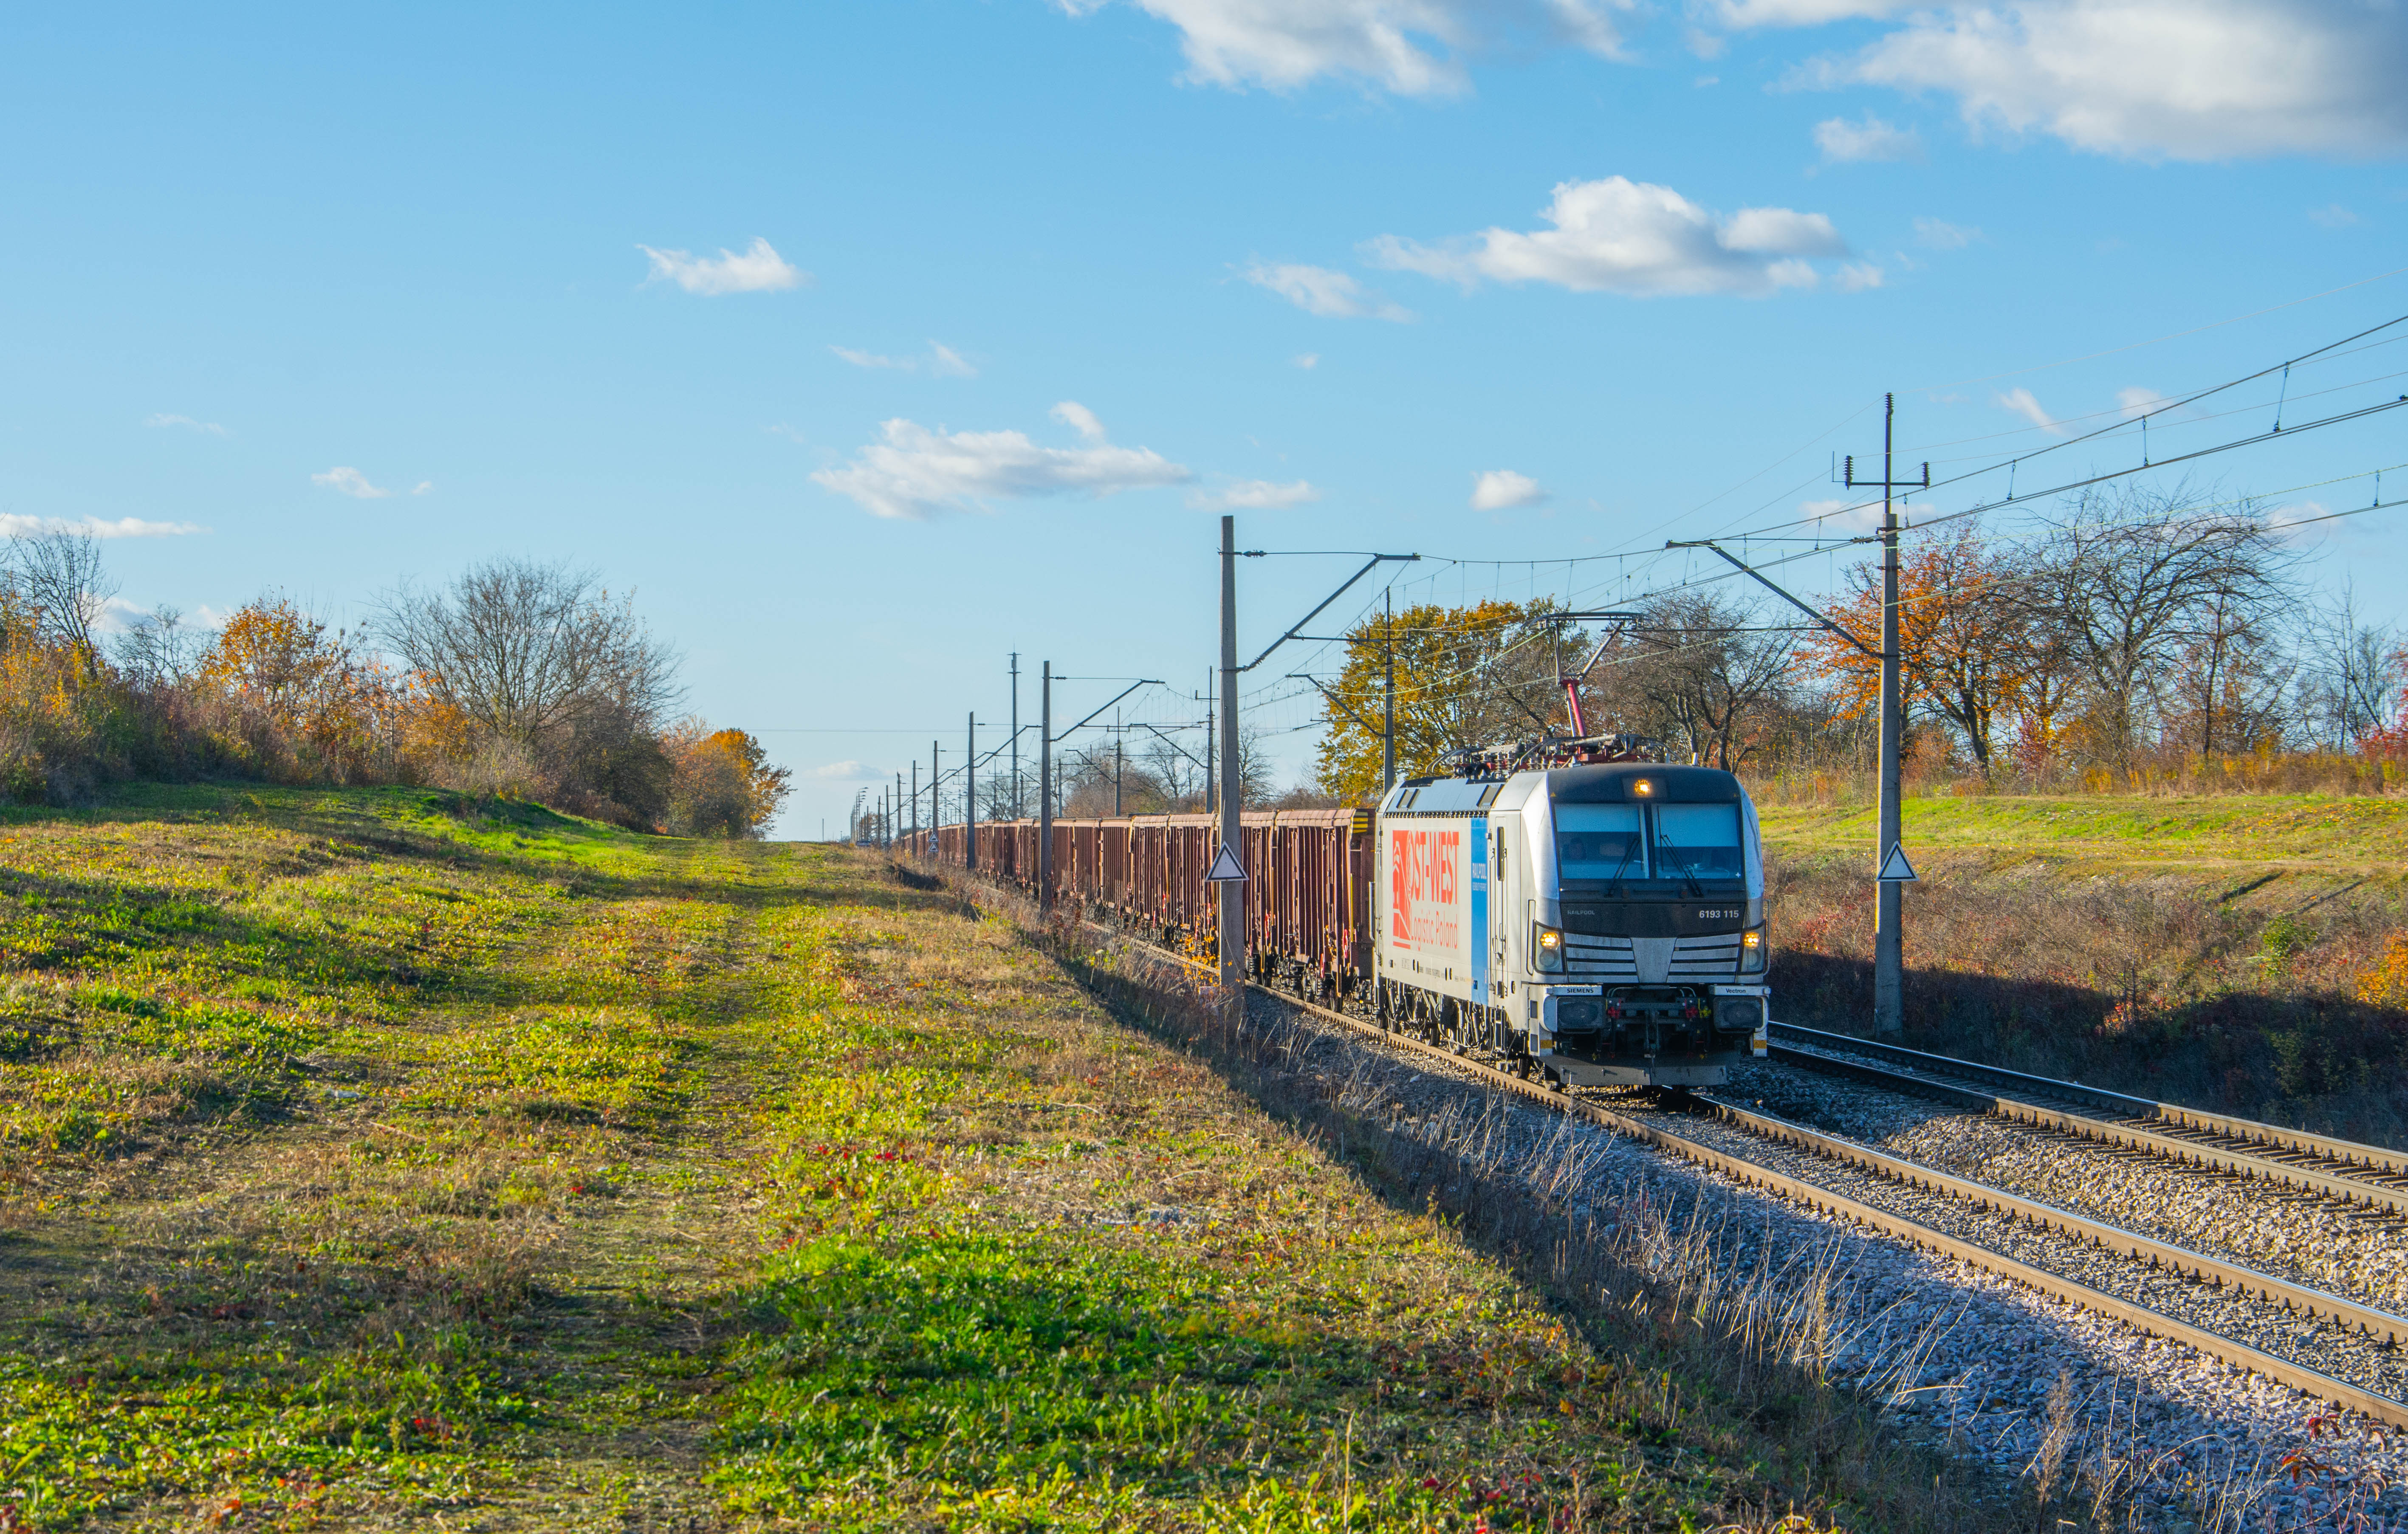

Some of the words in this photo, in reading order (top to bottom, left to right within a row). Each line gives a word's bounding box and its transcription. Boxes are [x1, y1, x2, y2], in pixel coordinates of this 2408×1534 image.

[1406, 830, 1459, 905] OST-WEST
[1411, 906, 1434, 952] Logistic
[1436, 910, 1458, 950] Poland
[1699, 910, 1720, 918] 6193
